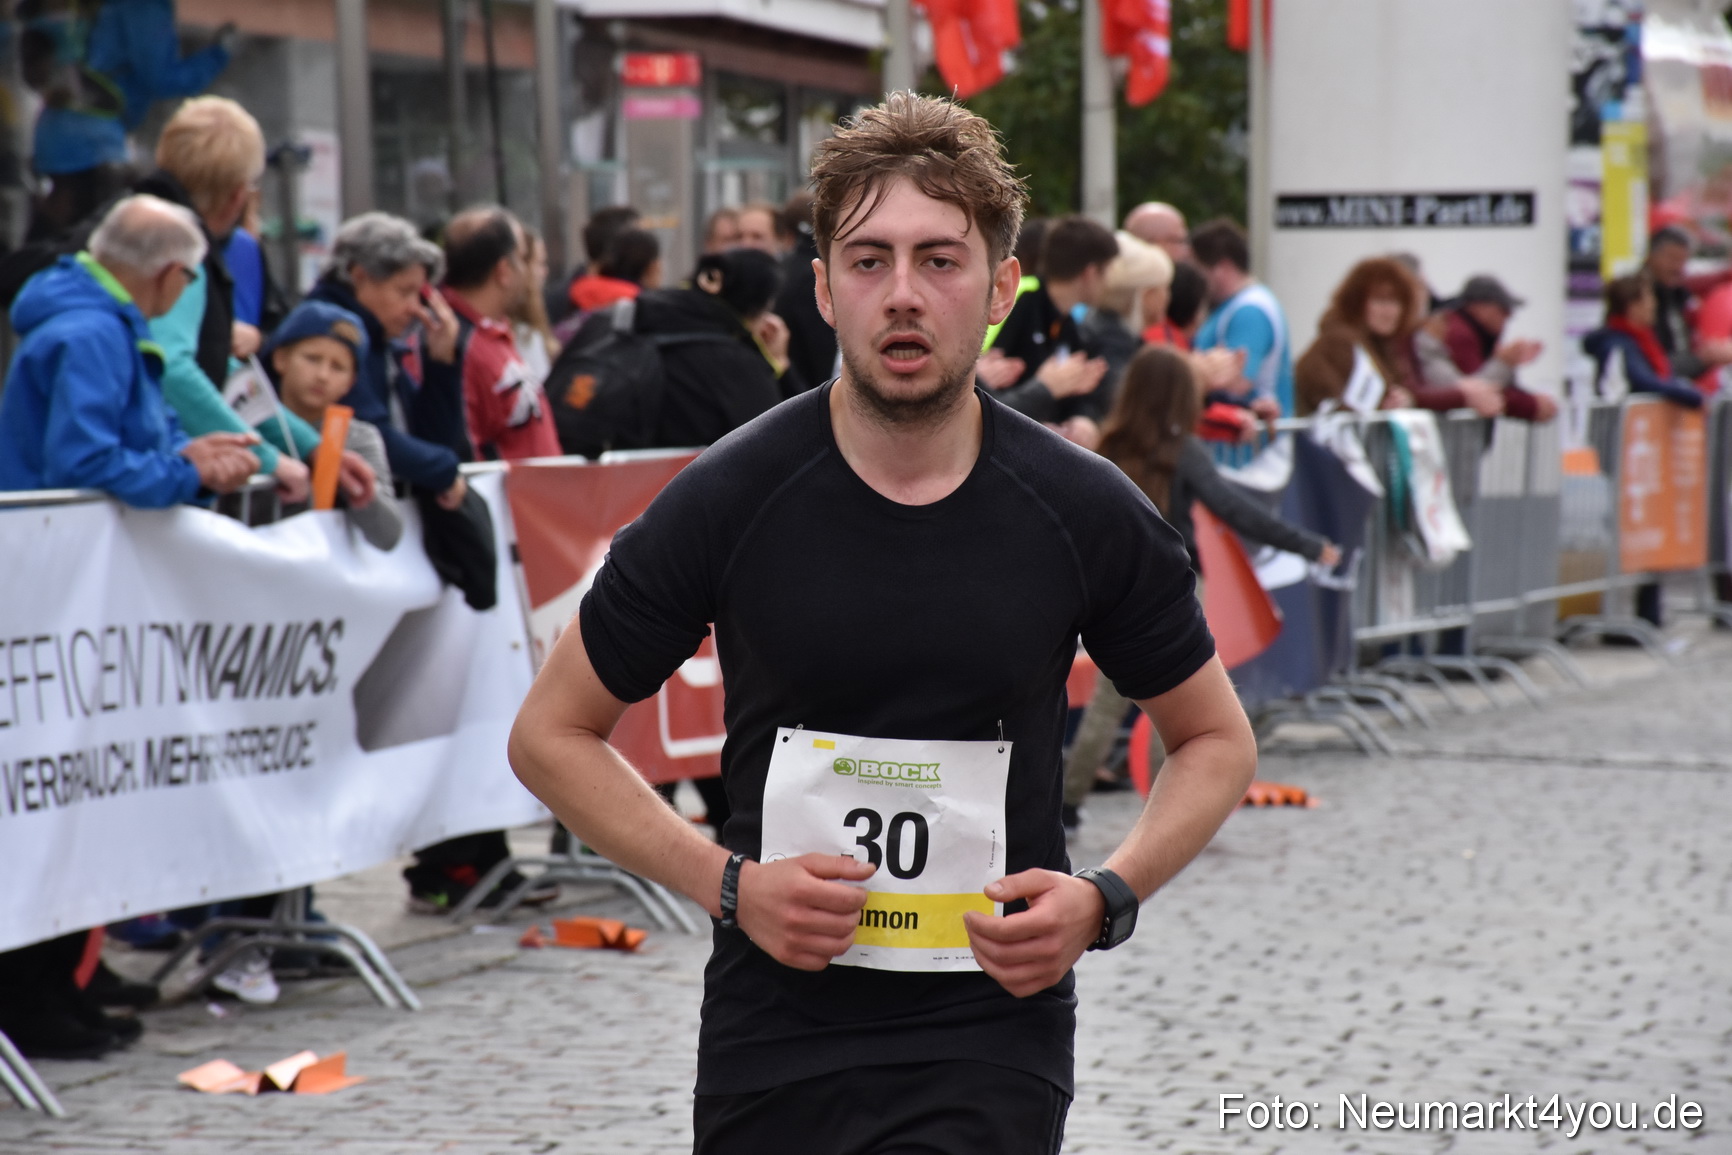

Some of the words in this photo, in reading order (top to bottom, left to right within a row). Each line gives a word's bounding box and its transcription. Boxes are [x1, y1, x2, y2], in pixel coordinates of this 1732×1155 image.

[858, 760, 941, 781] BOCK
[857, 778, 884, 786] inspired
[841, 808, 929, 880] 30
[858, 908, 919, 930] imon
